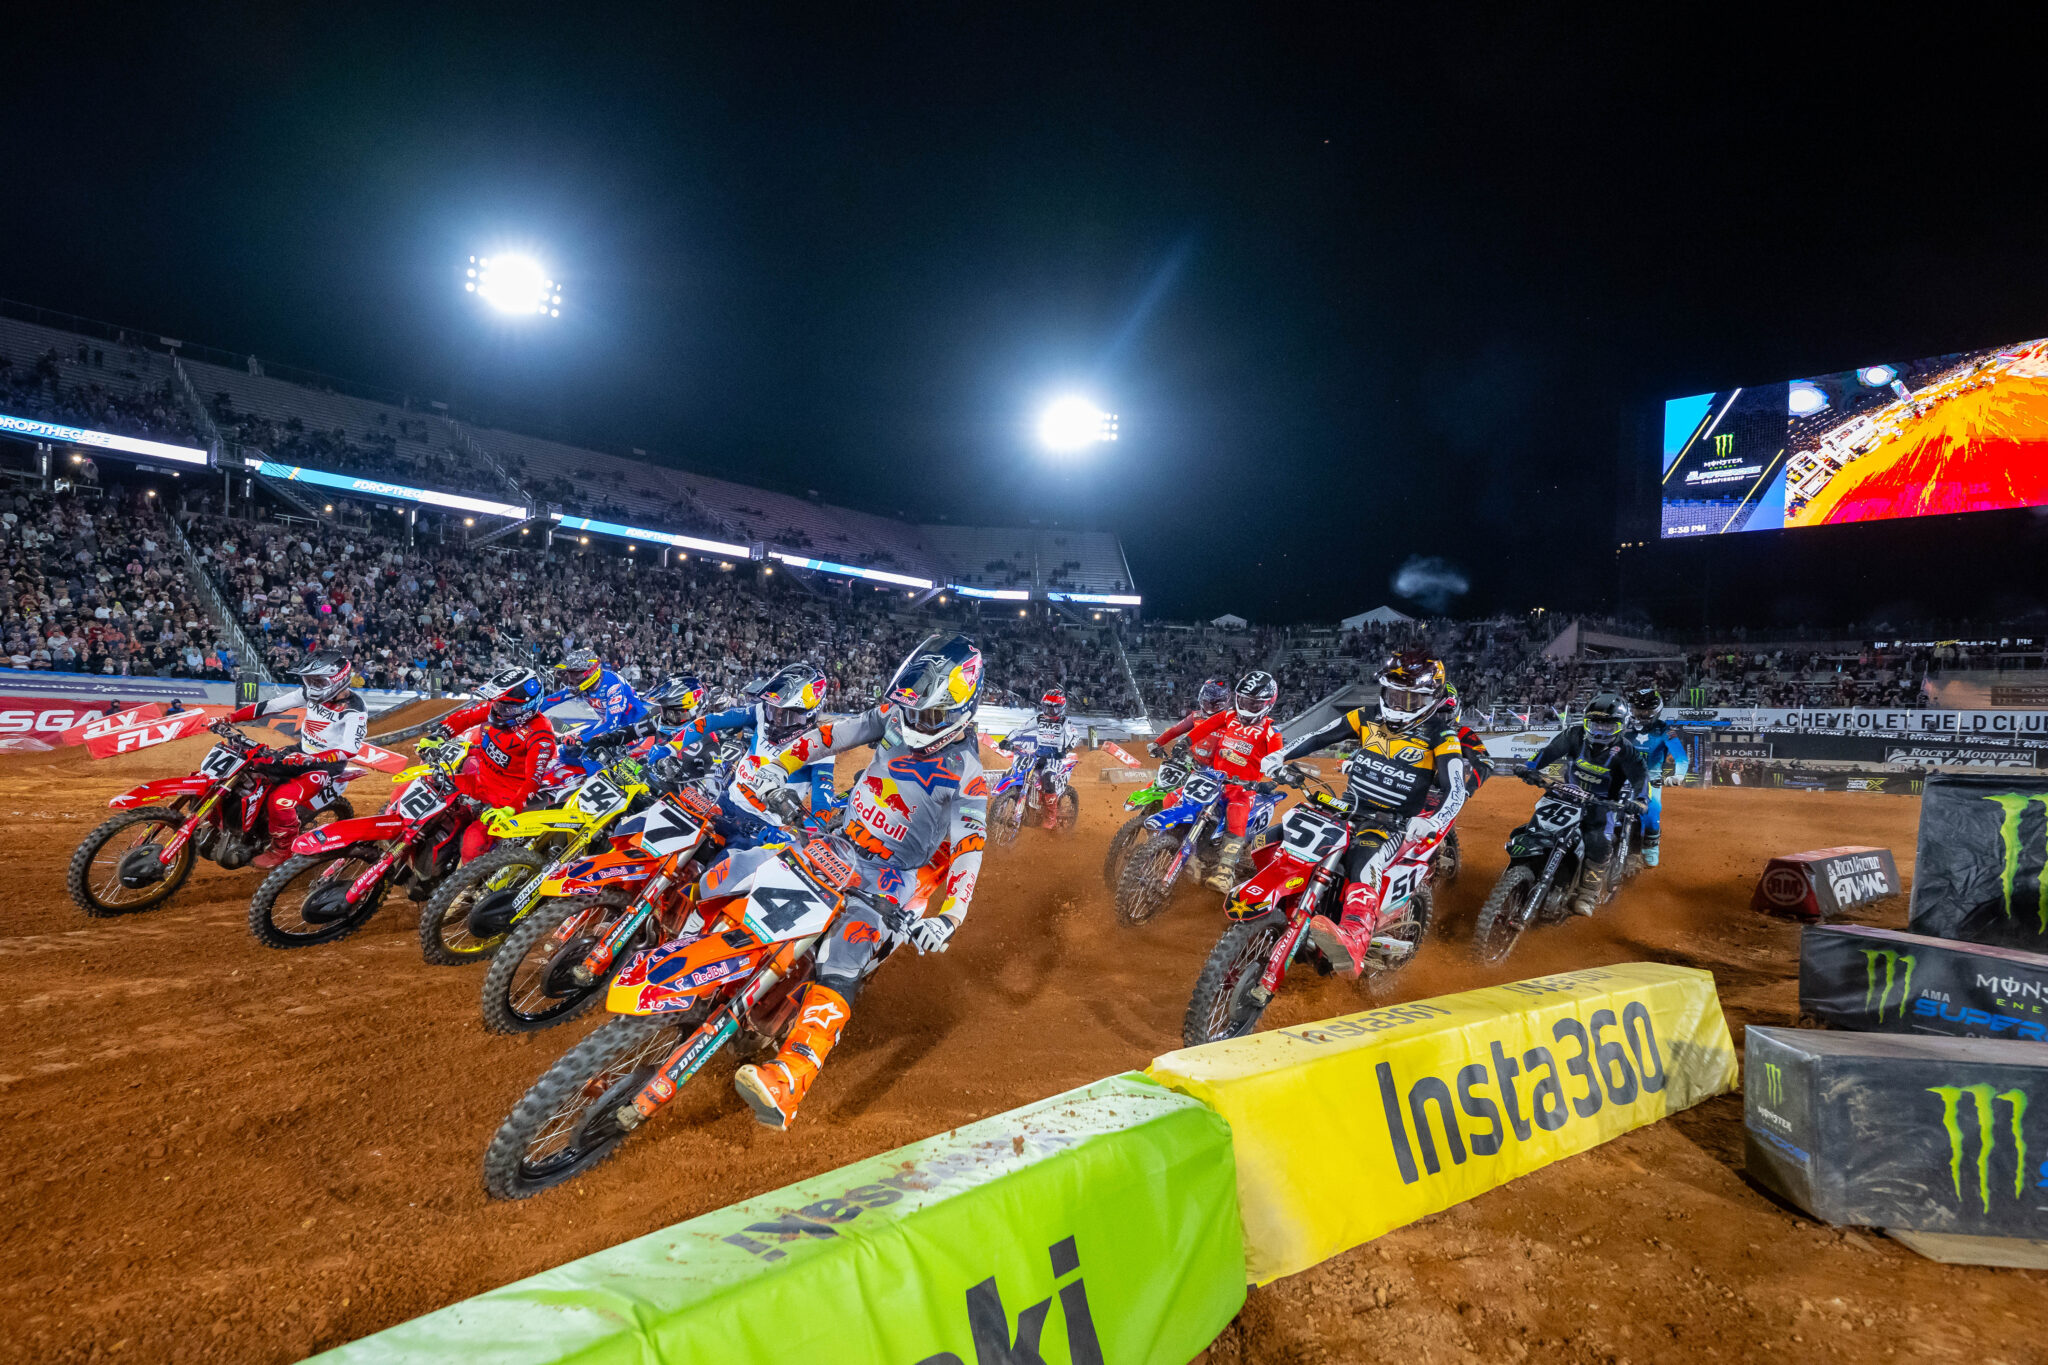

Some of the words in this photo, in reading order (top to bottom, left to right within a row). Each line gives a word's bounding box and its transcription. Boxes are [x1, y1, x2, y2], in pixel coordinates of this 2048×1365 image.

[1691, 524, 1707, 533] PM
[86, 711, 138, 735] FLY
[117, 721, 181, 753] FLY
[1227, 720, 1262, 740] FXR
[1786, 713, 1913, 729] CHEVROLET
[1922, 714, 1987, 730] FIELD
[1993, 715, 2048, 731] CLU
[202, 750, 237, 776] 14
[1114, 750, 1134, 766] FLY
[1726, 749, 1767, 757] SPORTS
[1910, 748, 1954, 757] ROCKY
[1955, 749, 2032, 760] MOUNTAIN
[1355, 754, 1416, 783] GASGAS
[318, 785, 337, 804] 14
[401, 787, 437, 818] 12
[578, 781, 619, 813] 94
[1184, 778, 1218, 801] 43
[644, 808, 697, 844] 7
[852, 790, 876, 820] Red
[872, 810, 908, 842] Bull
[1252, 811, 1270, 833] 43
[1536, 802, 1579, 827] 46
[844, 819, 894, 861] KTM
[1285, 812, 1347, 857] 51
[807, 848, 845, 882] RENTHAL
[814, 842, 851, 876] RENTHAL
[511, 871, 546, 908] DUNLOP
[1391, 868, 1418, 903] 51
[751, 886, 820, 934] 4
[621, 912, 647, 943] MOTOREX
[691, 970, 713, 986] Red
[710, 962, 730, 978] Bull
[1921, 989, 1950, 1003] AMA
[1996, 999, 2043, 1014] ENE
[1280, 1003, 1451, 1045] Insta360
[691, 1032, 732, 1073] MOTOREX
[1375, 1001, 1666, 1185] Insta360
